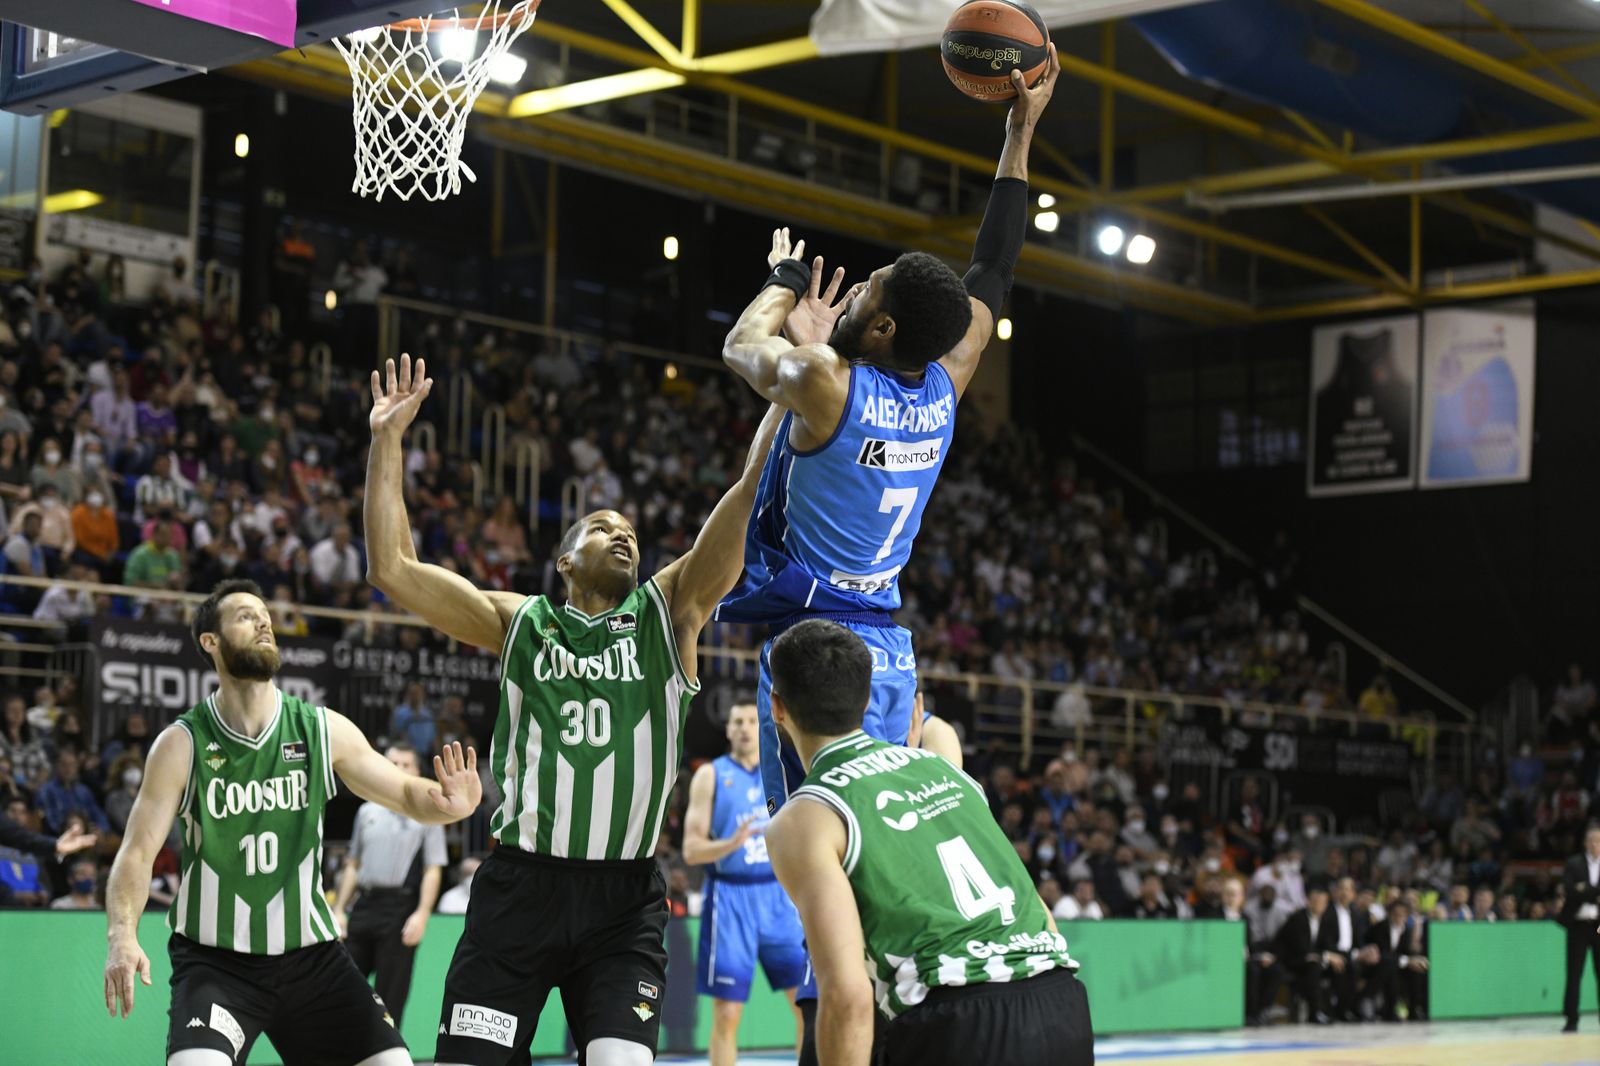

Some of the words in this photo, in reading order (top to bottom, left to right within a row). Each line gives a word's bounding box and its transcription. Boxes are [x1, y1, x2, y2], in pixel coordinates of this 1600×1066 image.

[947, 41, 995, 60] endesa
[995, 48, 1022, 64] liga
[871, 487, 919, 565] 7
[560, 698, 611, 747] 30
[239, 831, 279, 876] 10
[936, 835, 1016, 925] 4
